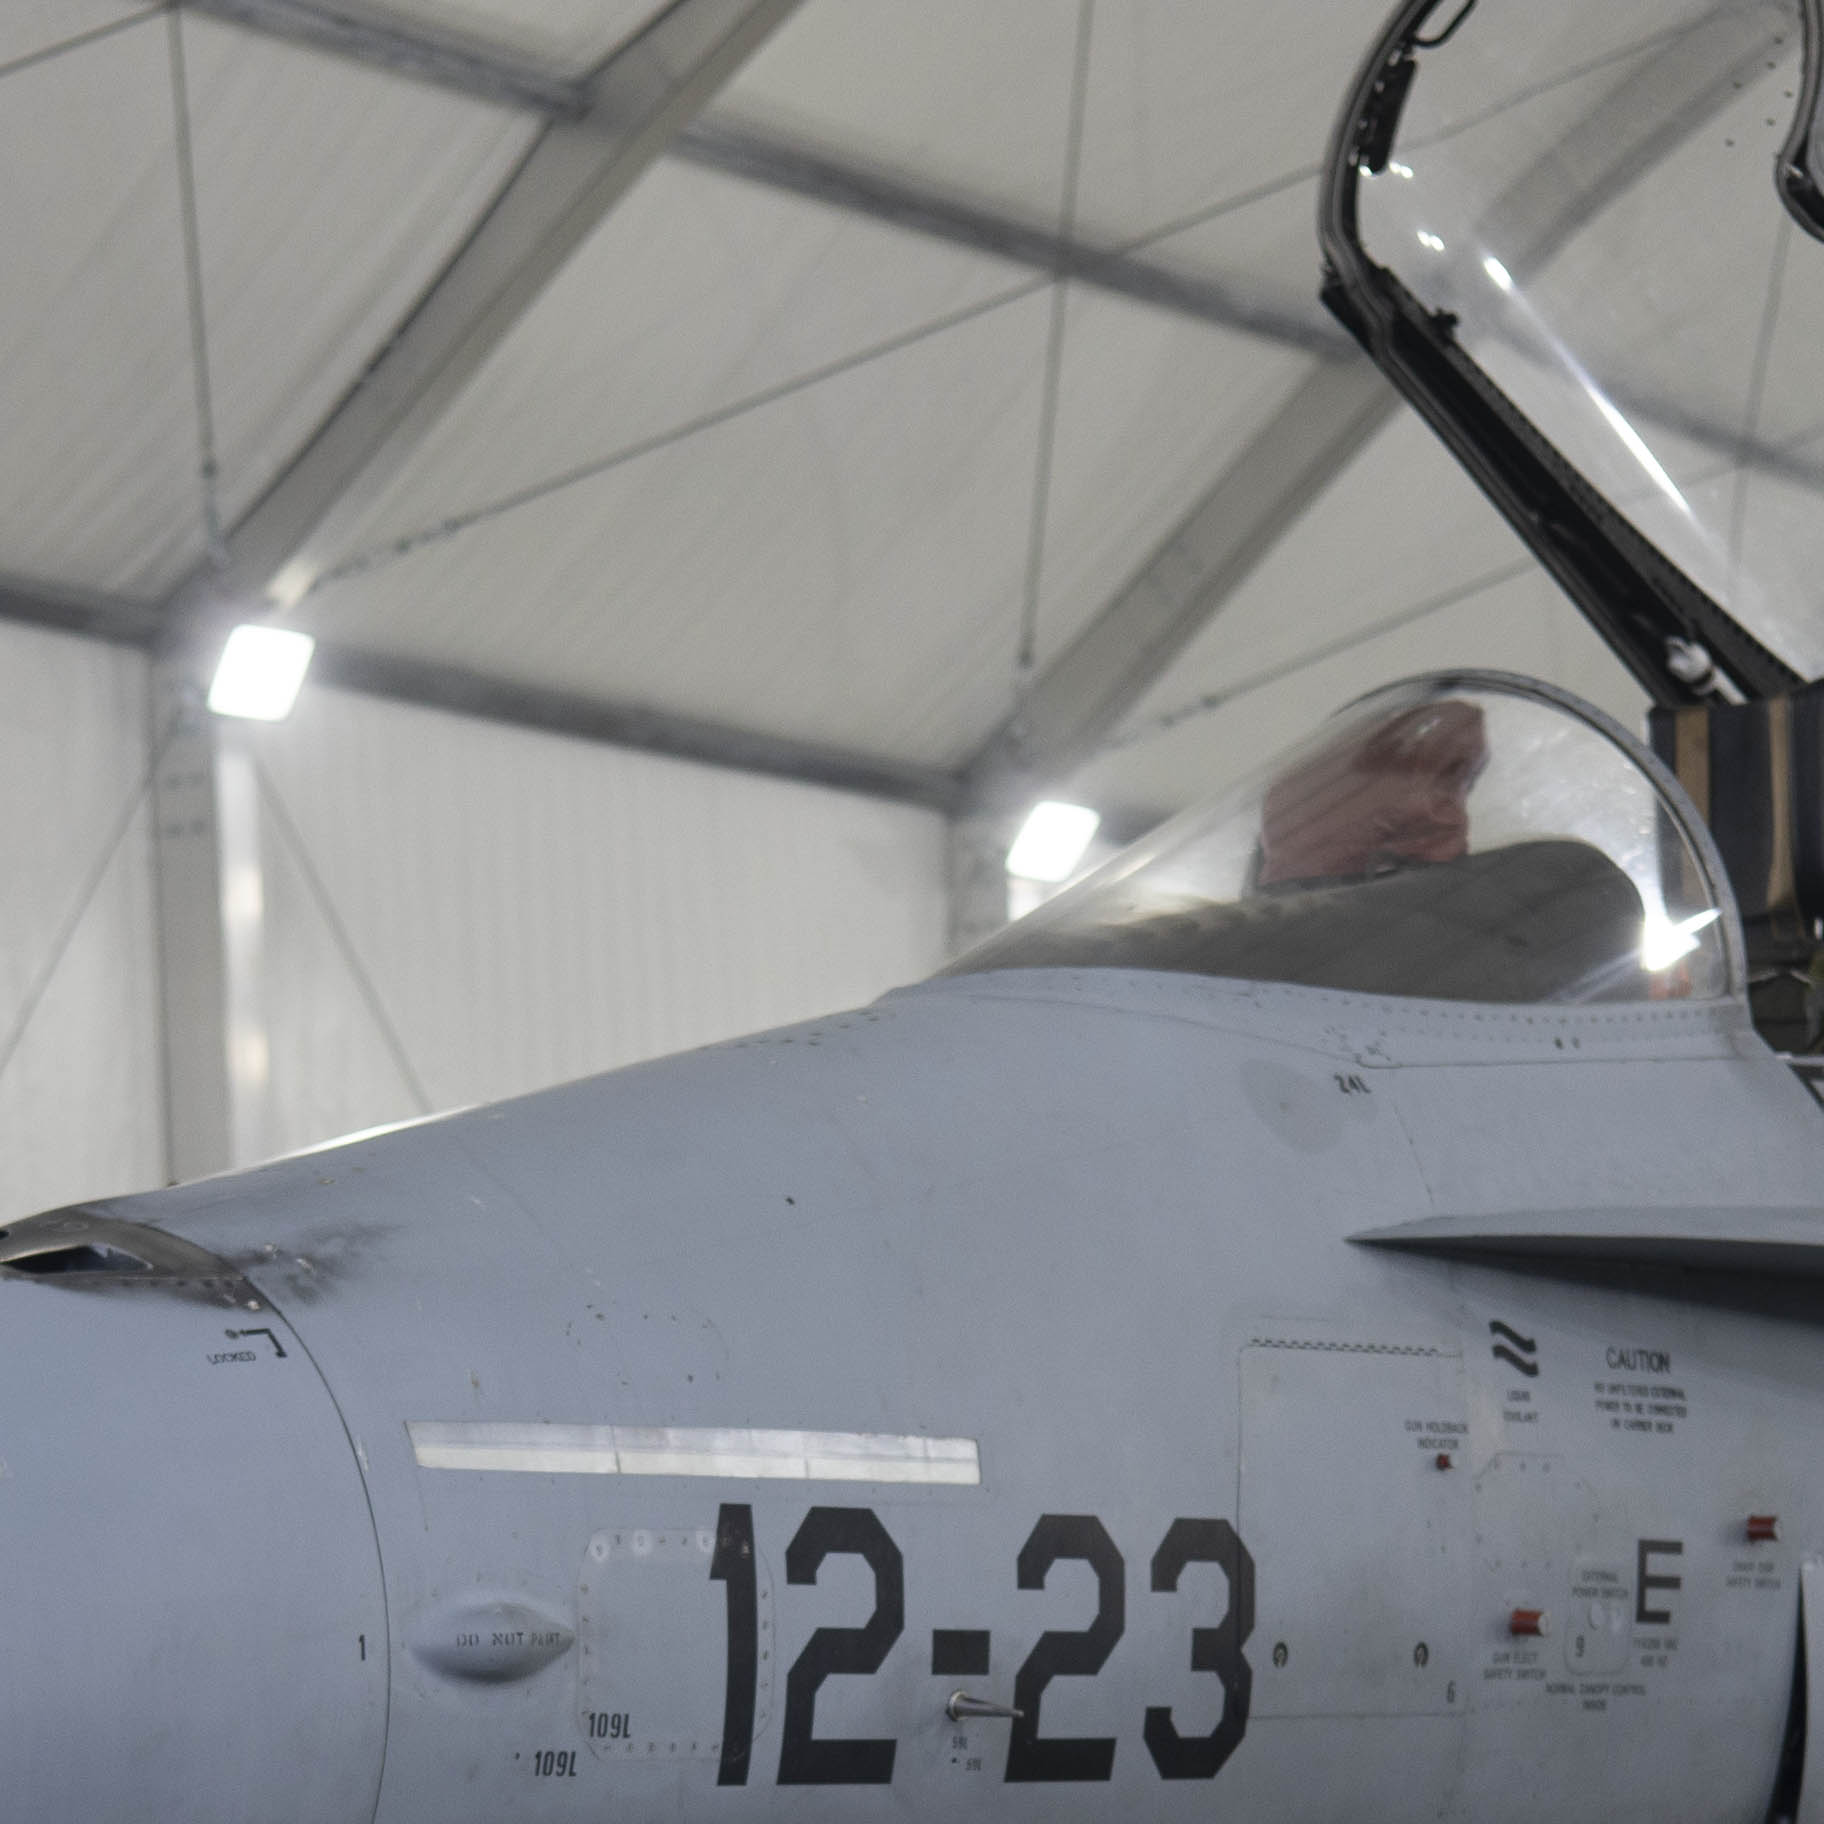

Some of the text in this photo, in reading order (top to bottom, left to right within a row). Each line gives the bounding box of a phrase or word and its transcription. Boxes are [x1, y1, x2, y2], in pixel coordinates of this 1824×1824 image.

[205, 1351, 256, 1366] LOCKED
[1607, 1347, 1670, 1374] CAUTION
[1417, 1438, 1459, 1450] INDICATOR
[1635, 1539, 1683, 1625] E
[456, 1632, 480, 1647] DO
[491, 1631, 524, 1647] NOT
[709, 1503, 1255, 1785] 12-23
[1483, 1669, 1513, 1680] SAFETY
[588, 1712, 631, 1739] 109L
[534, 1750, 577, 1777] 109L
